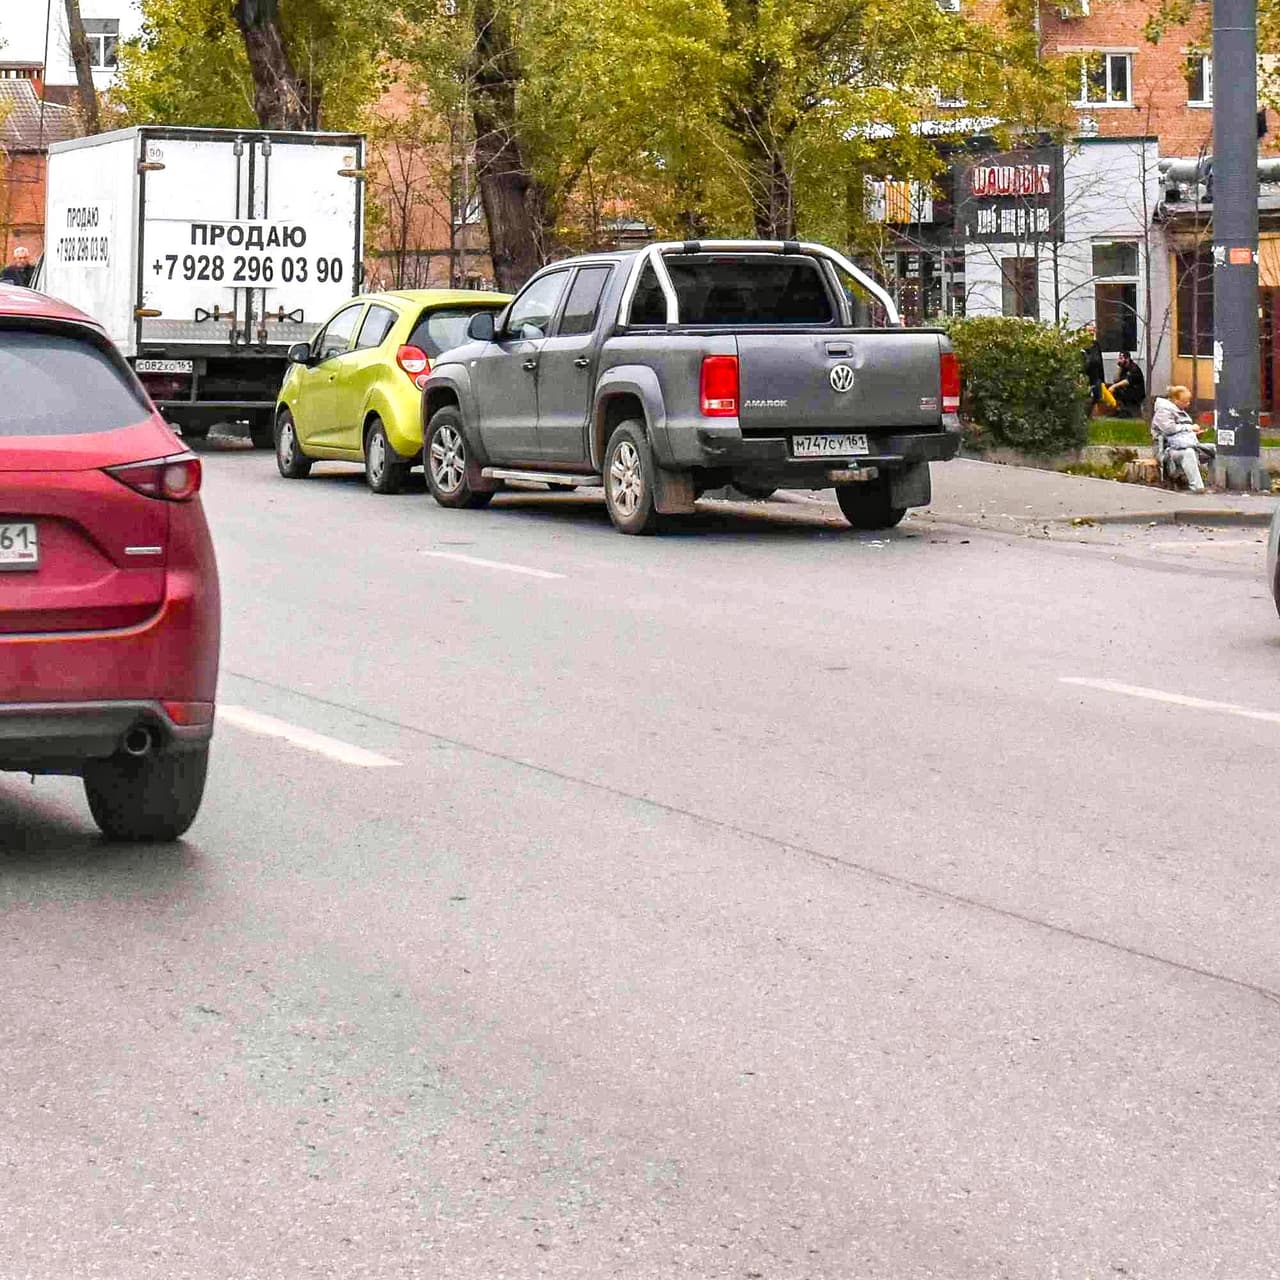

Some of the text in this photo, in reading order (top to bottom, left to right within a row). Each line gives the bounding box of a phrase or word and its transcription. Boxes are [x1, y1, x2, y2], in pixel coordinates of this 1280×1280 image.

[66, 207, 99, 231] ПРОДАЮ
[90, 236, 98, 262] 03
[100, 236, 108, 261] 90
[191, 223, 307, 251] ПРОДАЮ
[152, 254, 343, 283] +7 928 296 03 90
[743, 399, 788, 408] AMAROK
